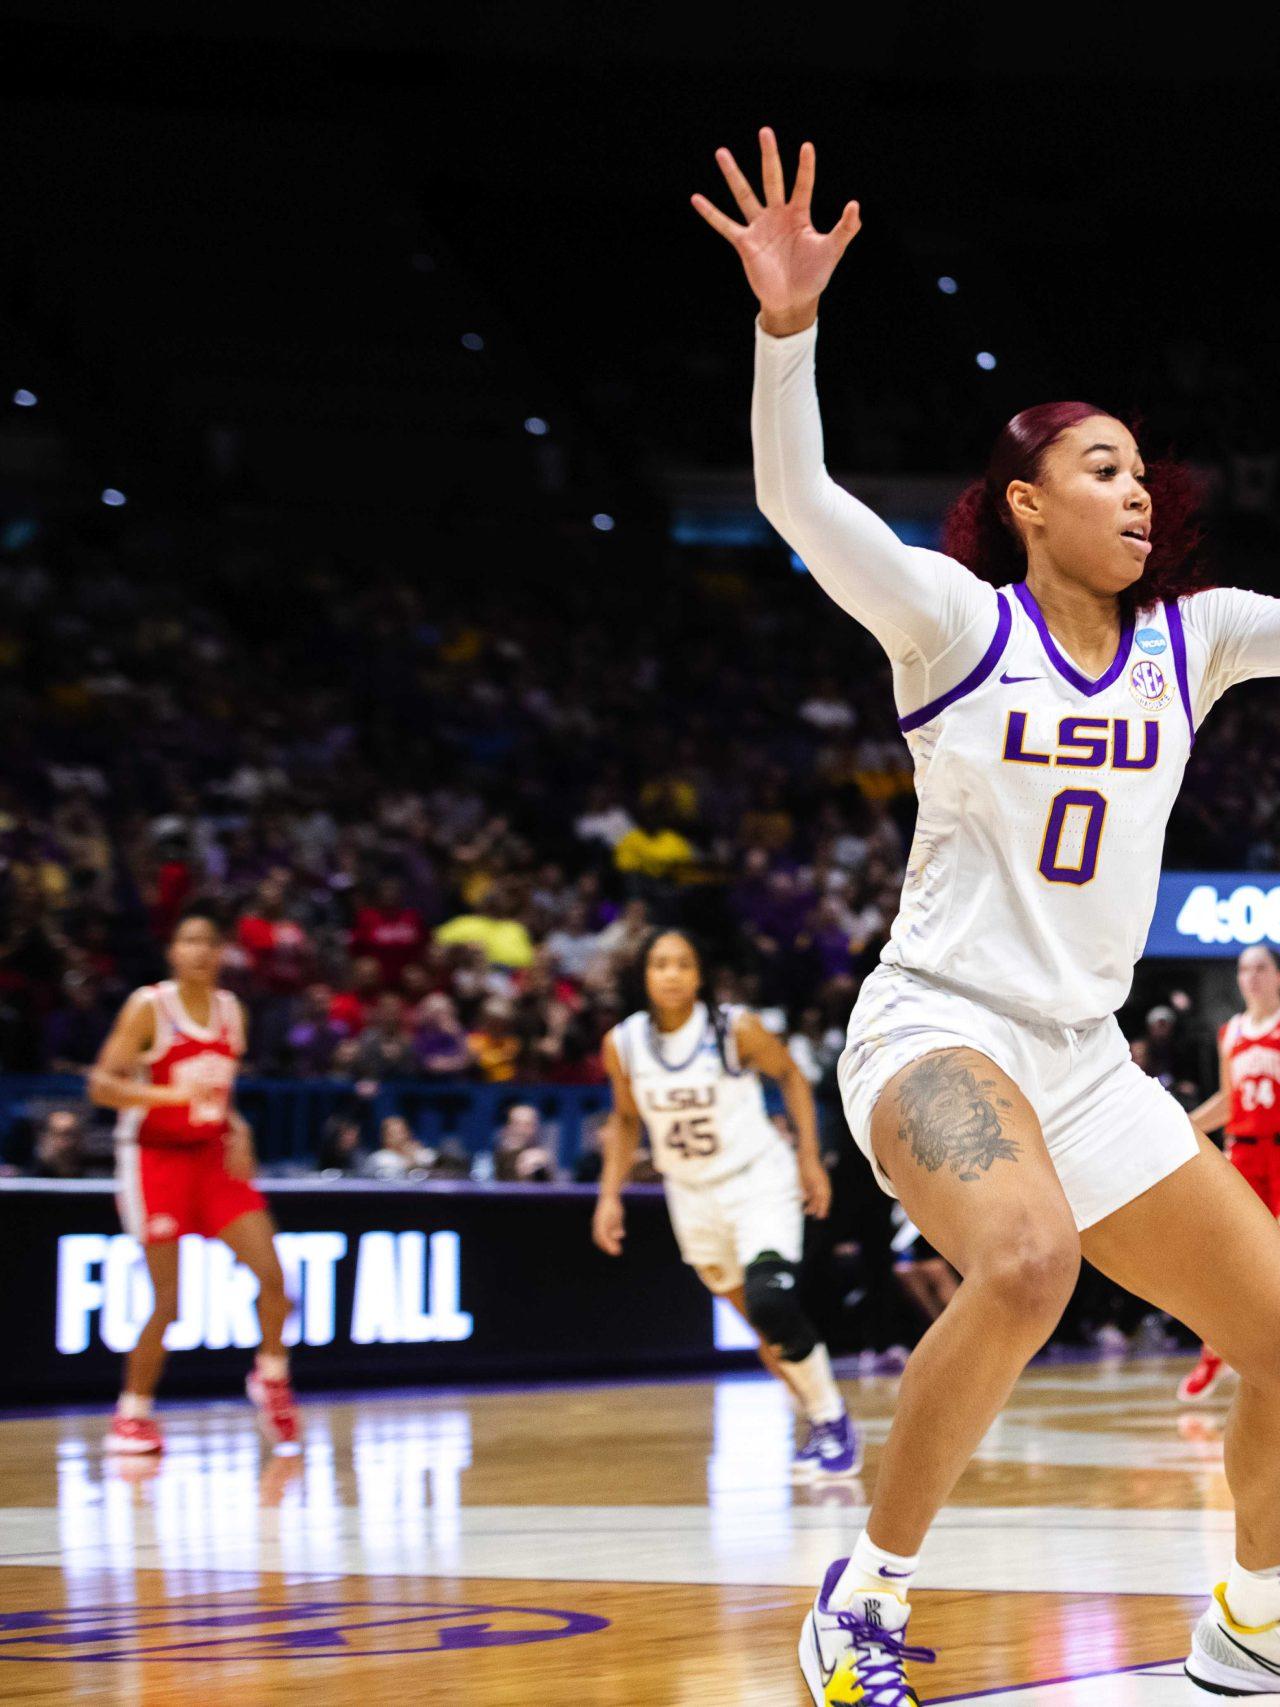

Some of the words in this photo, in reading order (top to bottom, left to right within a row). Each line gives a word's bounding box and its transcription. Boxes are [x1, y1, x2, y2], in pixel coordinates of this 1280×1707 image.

[1132, 661, 1164, 698] SEC
[1001, 710, 1159, 772] LSU
[1037, 785, 1110, 887] 0
[645, 1086, 717, 1112] LSU
[666, 1117, 719, 1159] 45
[350, 1230, 474, 1345] ALL
